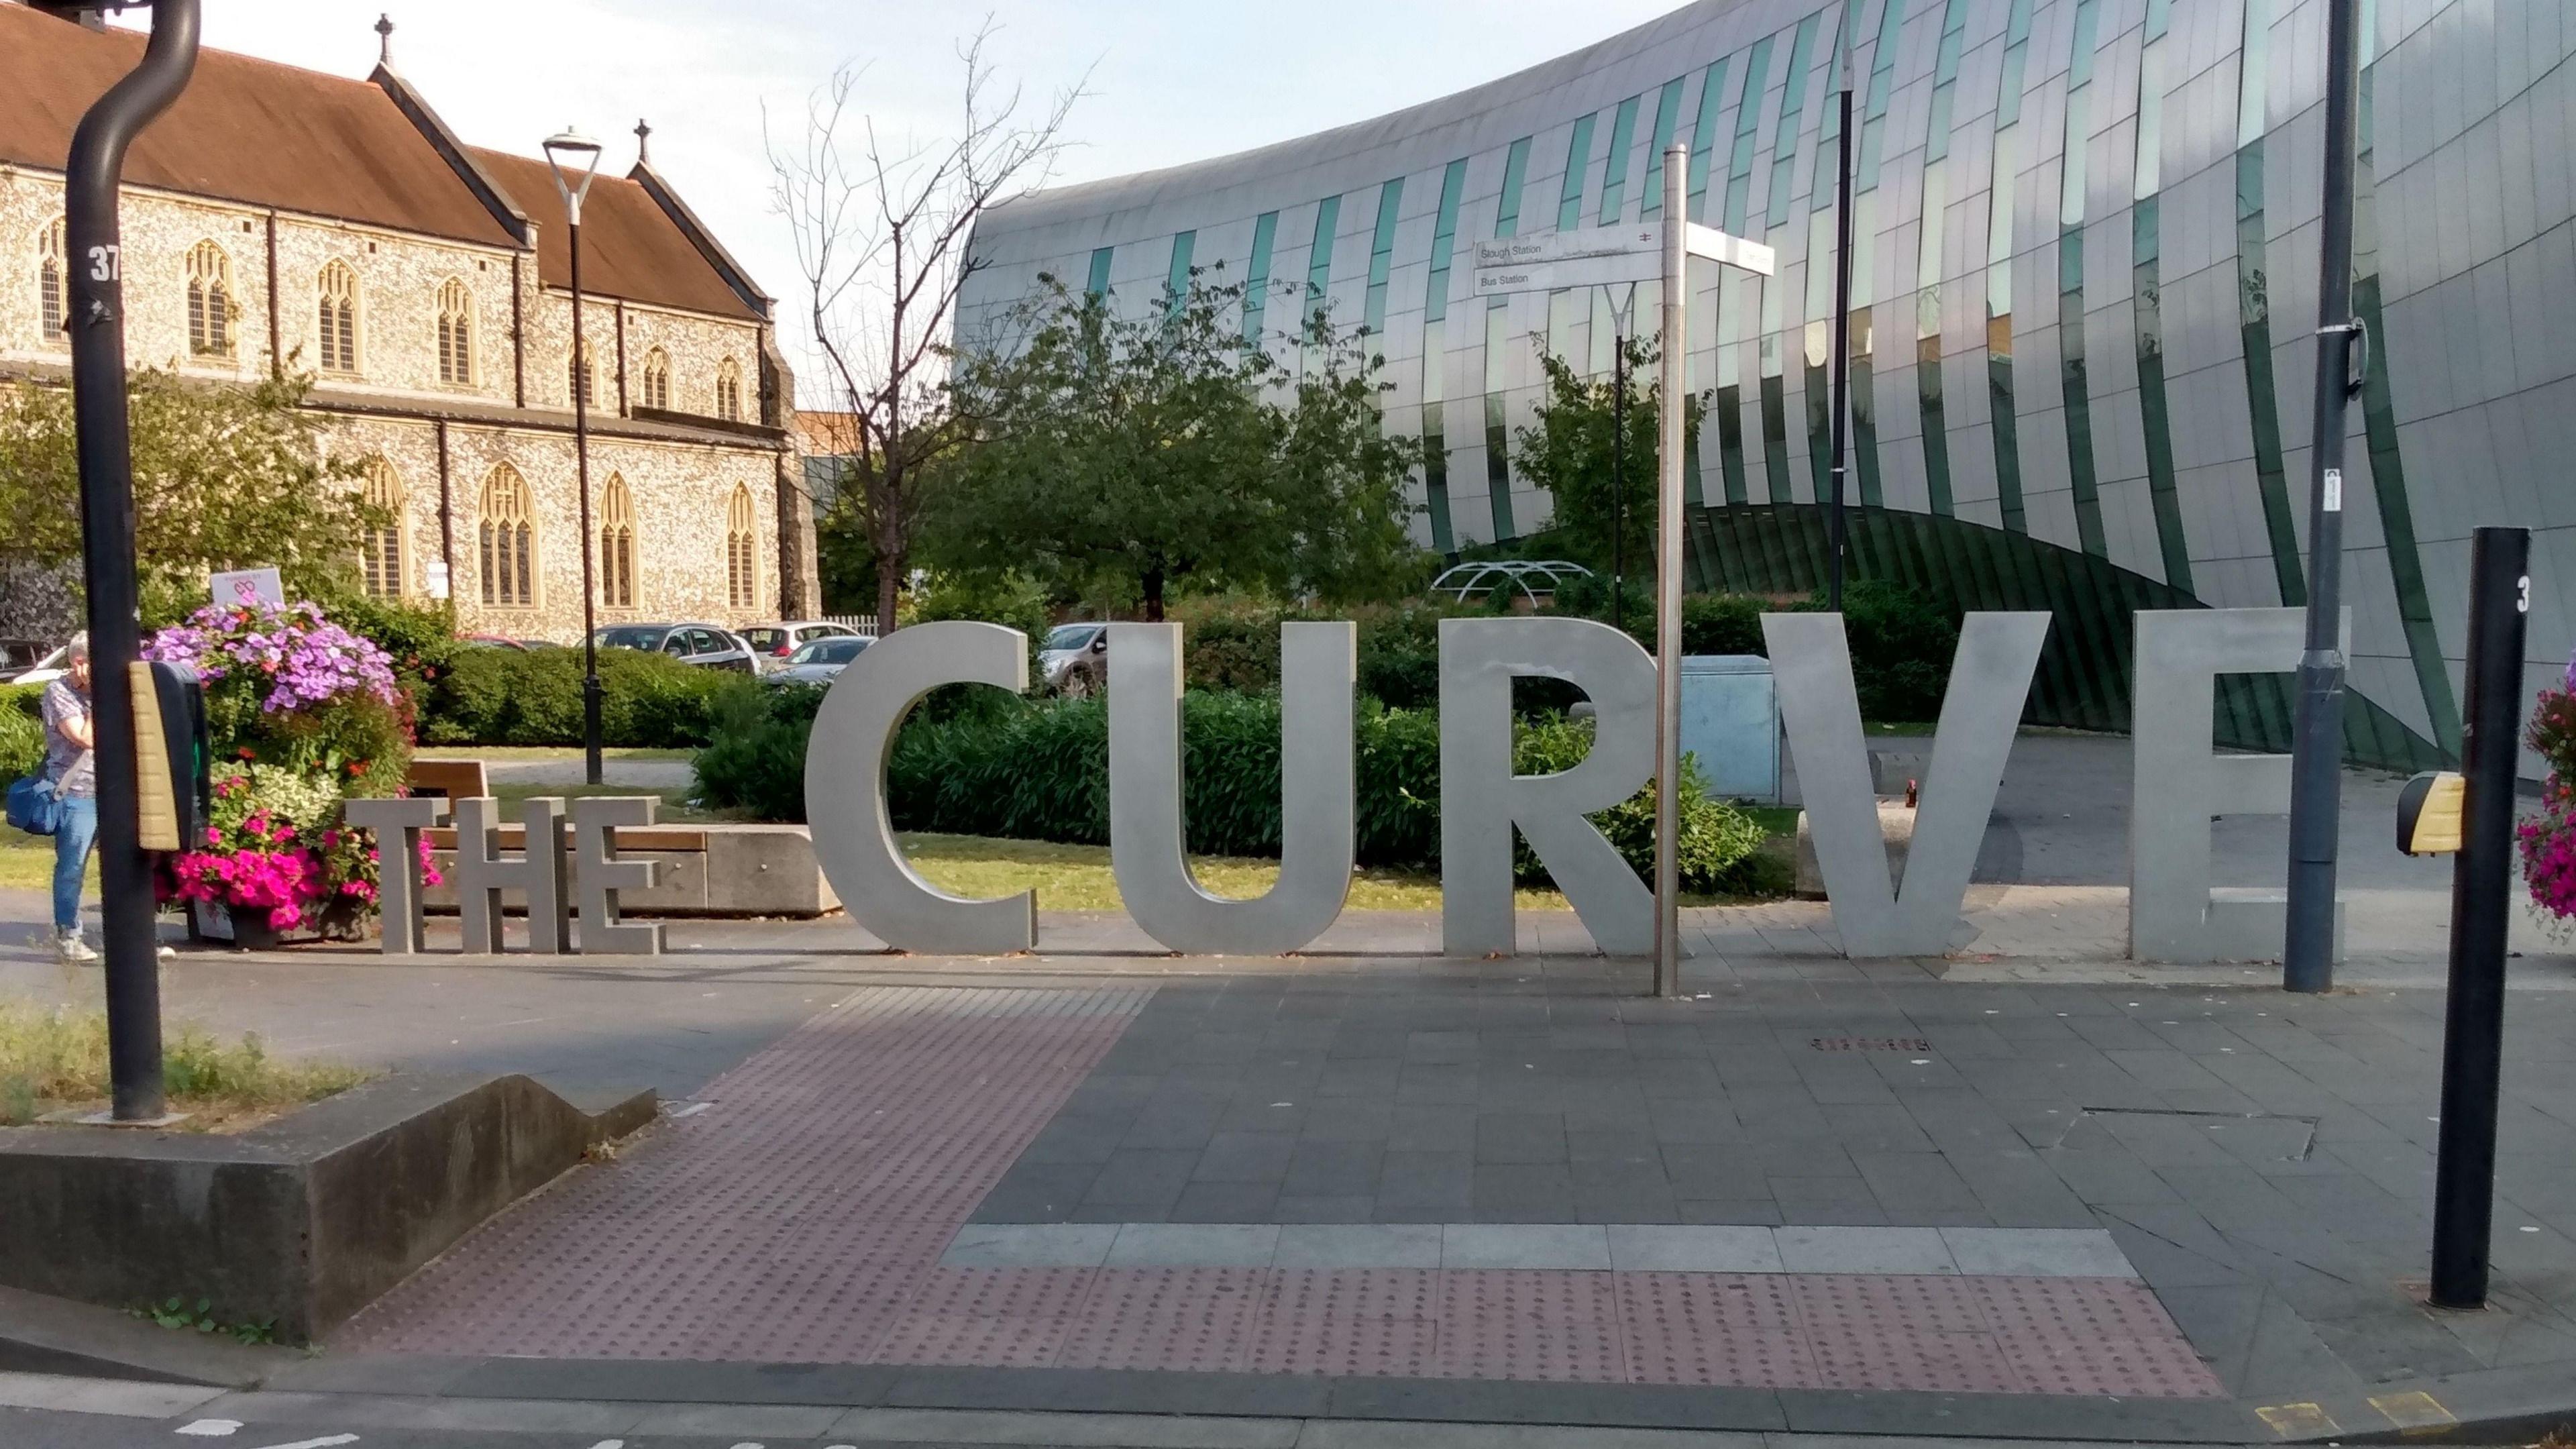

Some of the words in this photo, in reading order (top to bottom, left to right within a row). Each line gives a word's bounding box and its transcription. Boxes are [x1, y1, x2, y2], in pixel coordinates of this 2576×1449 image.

[89, 244, 119, 282] 37
[1481, 246, 1510, 259] Slough
[1512, 245, 1542, 256] Station
[1481, 278, 1497, 287] Bus
[1499, 274, 1529, 285] Station
[345, 796, 667, 955] THE
[804, 606, 2351, 963] CURVE
